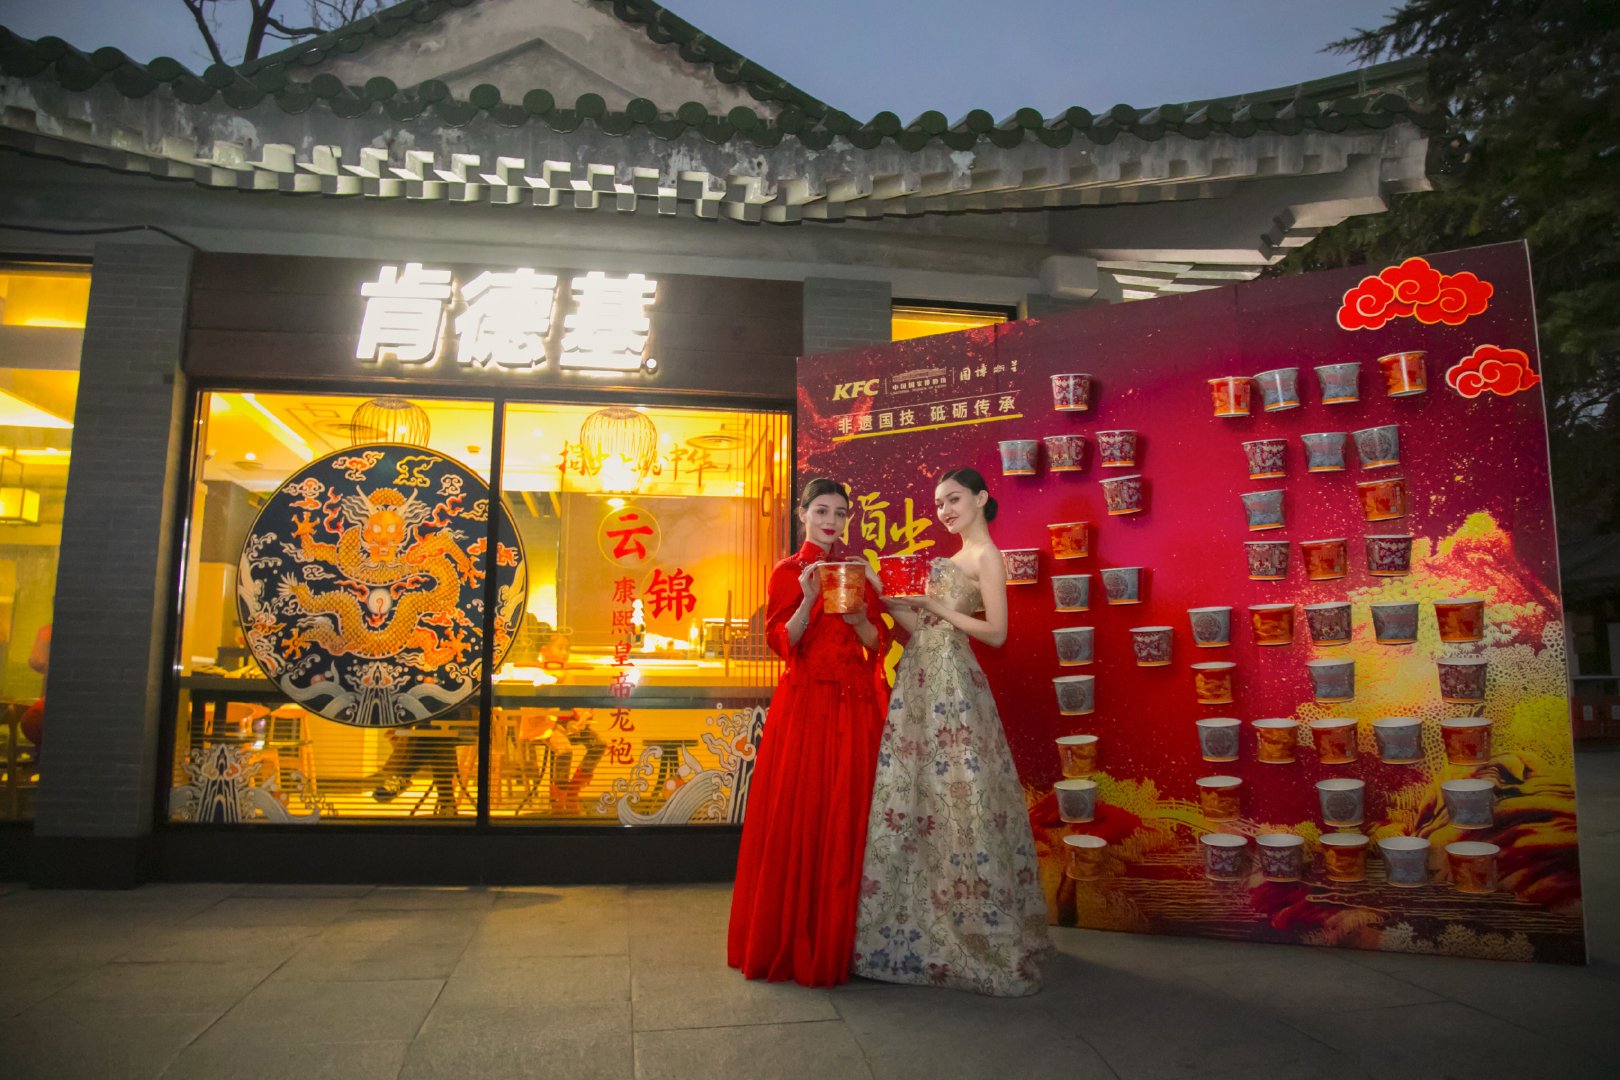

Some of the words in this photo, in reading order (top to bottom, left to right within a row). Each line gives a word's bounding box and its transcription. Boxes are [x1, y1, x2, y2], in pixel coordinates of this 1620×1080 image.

[356, 263, 657, 371] 肯德基
[832, 379, 880, 400] KFC
[838, 410, 915, 433] 非遗国技
[930, 396, 1015, 421] 砥砺传承
